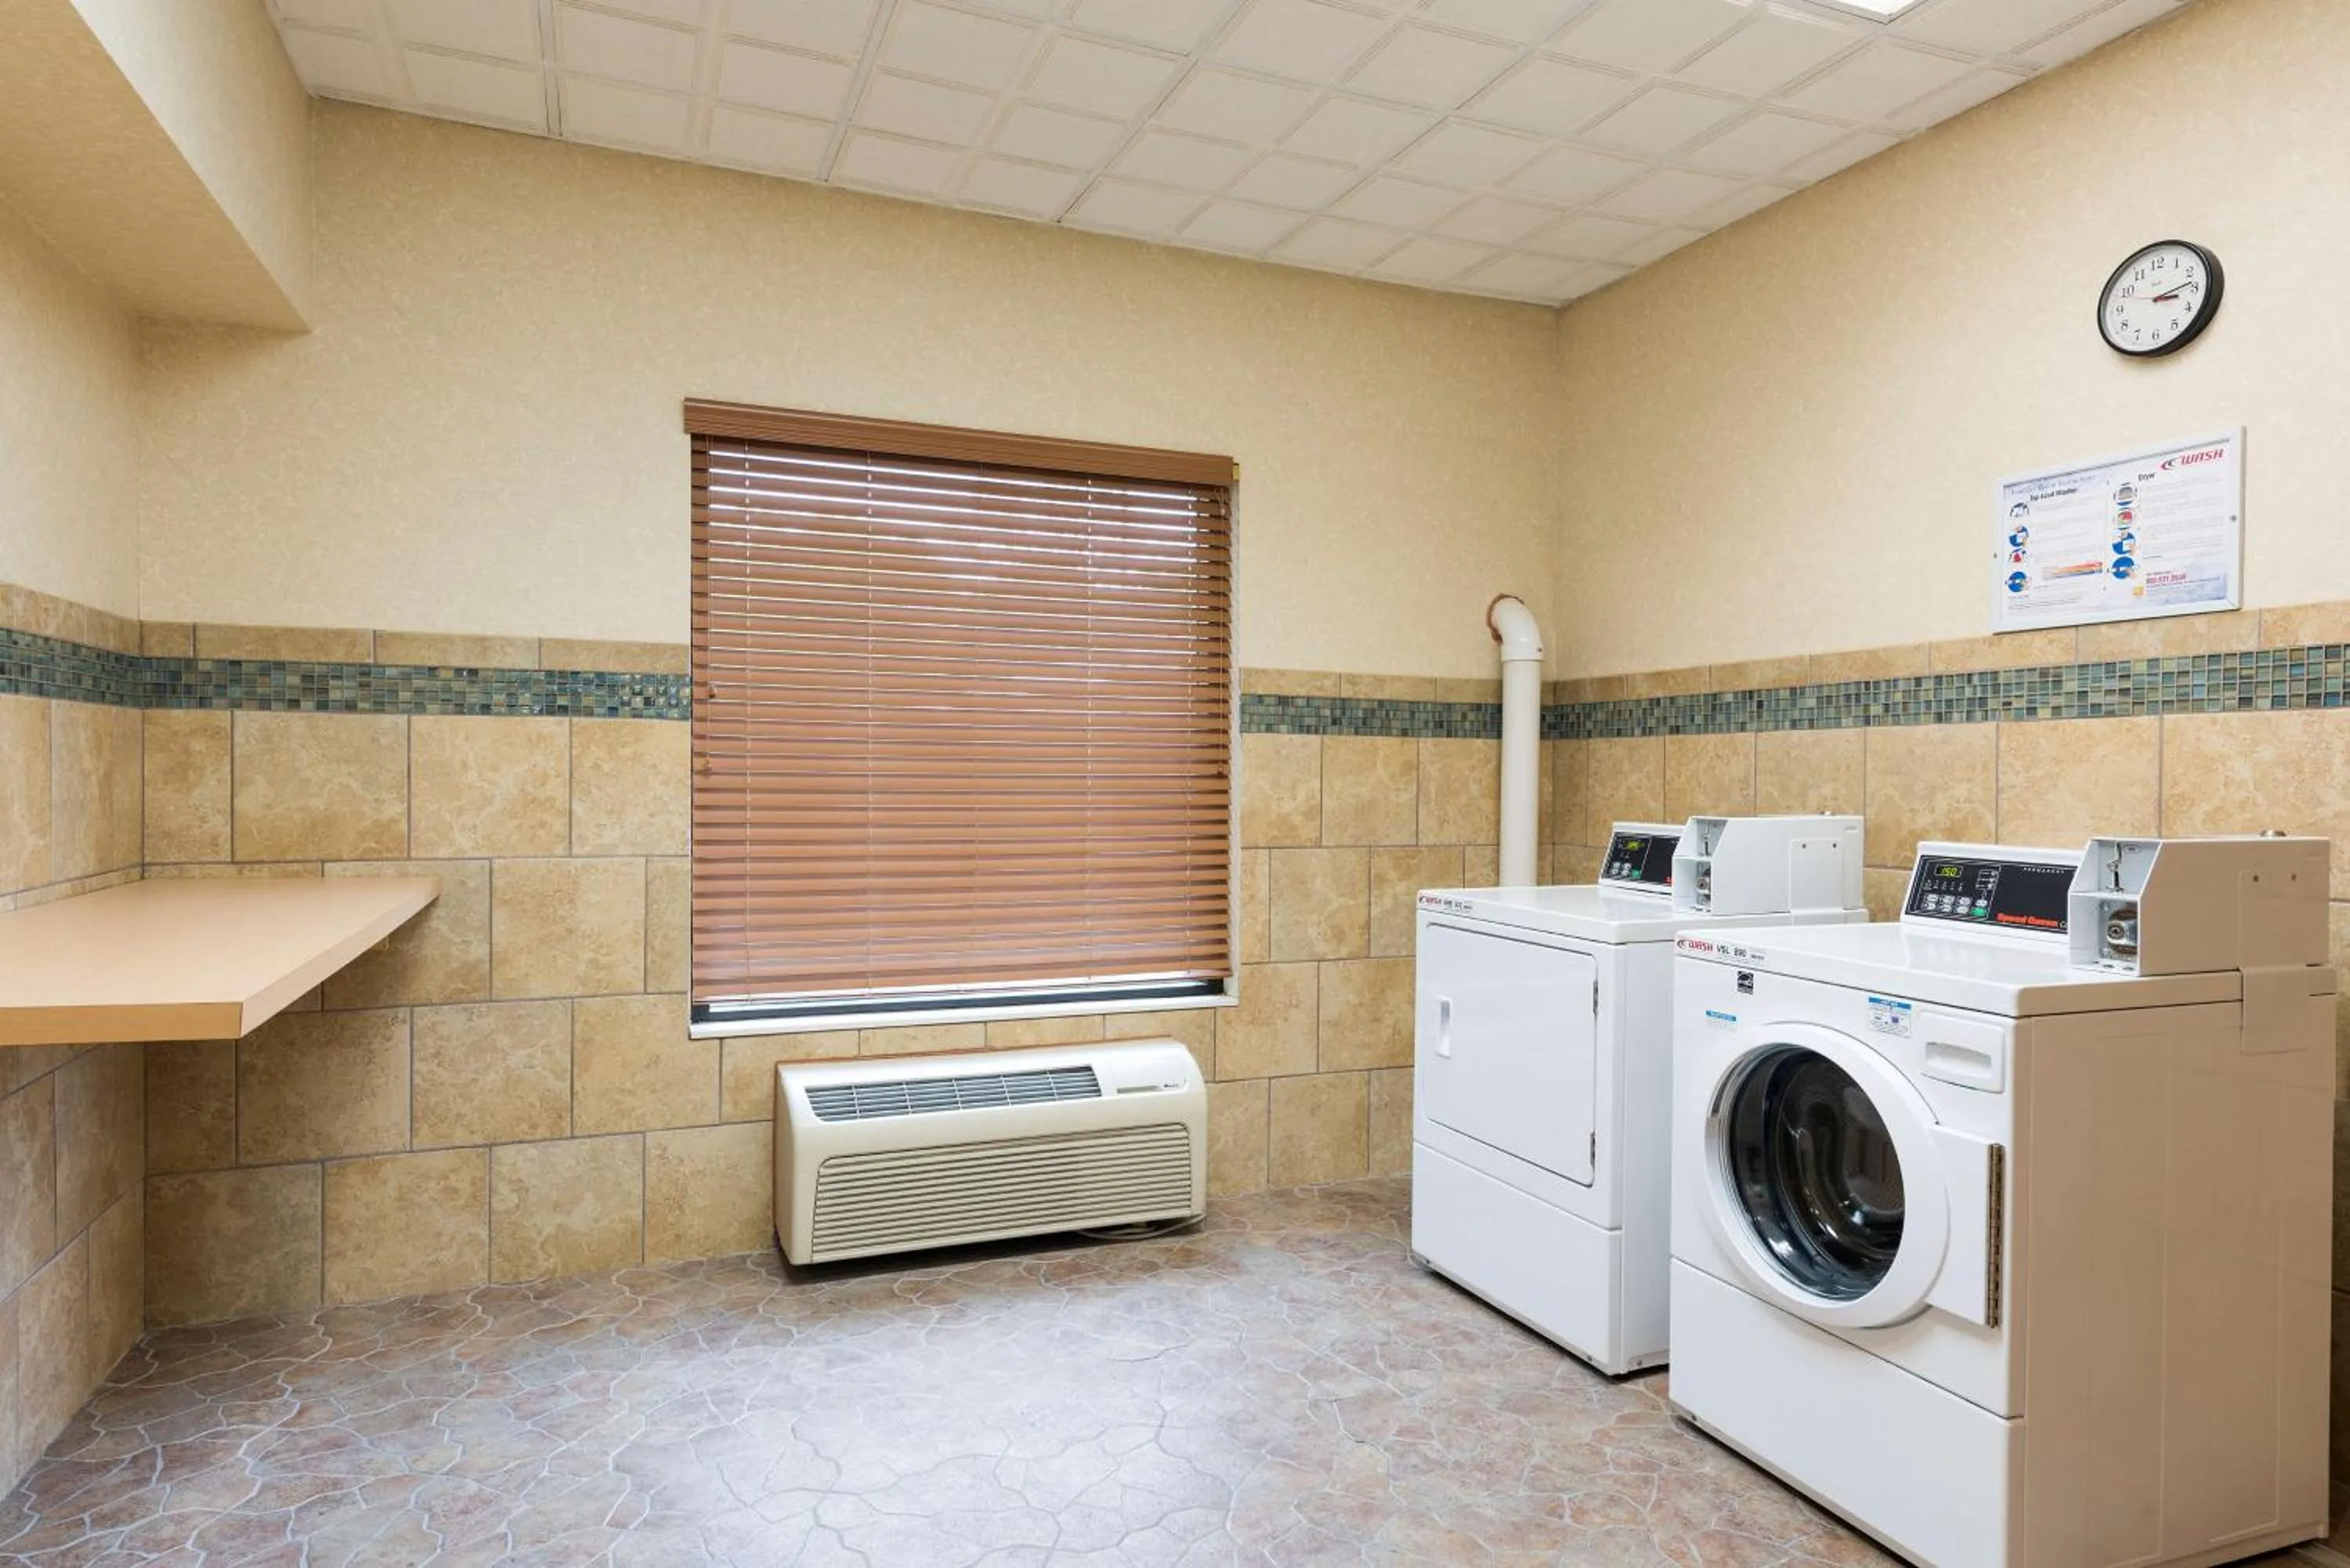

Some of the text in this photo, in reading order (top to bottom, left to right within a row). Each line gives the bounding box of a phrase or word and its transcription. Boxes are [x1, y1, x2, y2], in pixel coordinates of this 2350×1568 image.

[2150, 256, 2164, 271] 12
[2175, 257, 2179, 269] 1
[2135, 269, 2145, 281] 11
[2186, 266, 2194, 278] 2
[2122, 285, 2135, 298] 10
[2190, 282, 2199, 294] 3
[2116, 305, 2124, 316] 9
[2185, 301, 2193, 313] 4
[2120, 320, 2128, 331] 8
[2171, 317, 2179, 330] 5
[2134, 328, 2141, 341] 7
[2152, 329, 2160, 340] 6
[2180, 449, 2224, 465] WASH
[1688, 939, 1713, 952] WASH
